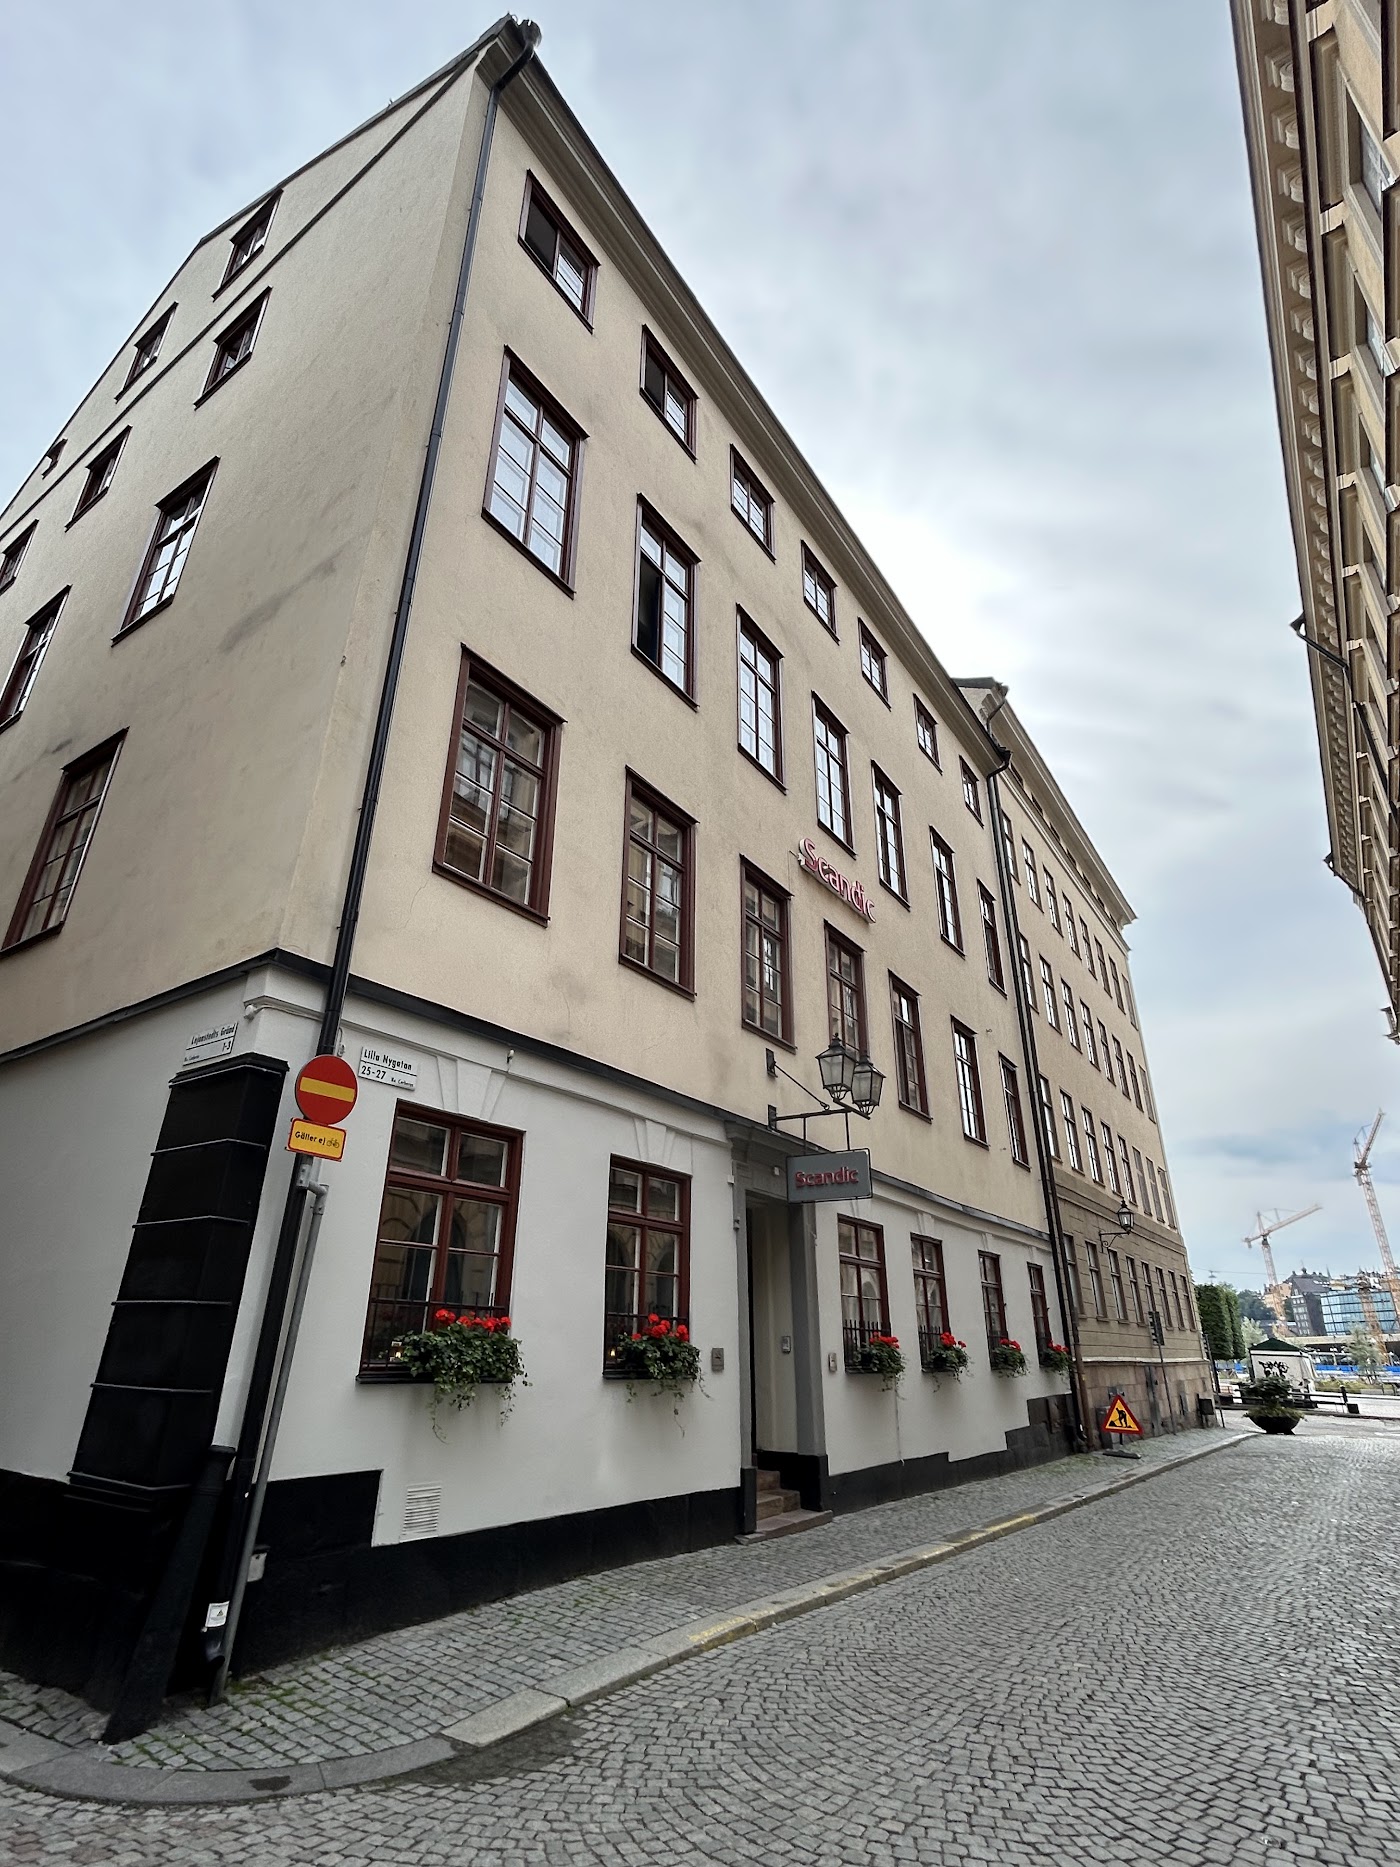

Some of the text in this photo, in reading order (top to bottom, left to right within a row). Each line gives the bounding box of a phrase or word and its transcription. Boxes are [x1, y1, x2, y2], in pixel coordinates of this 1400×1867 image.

[799, 837, 877, 923] Scandic
[364, 1049, 412, 1070] Lilla Nygatan
[361, 1065, 386, 1079] 25-27
[295, 1131, 326, 1146] Gäller ej
[795, 1166, 859, 1188] Scandic
